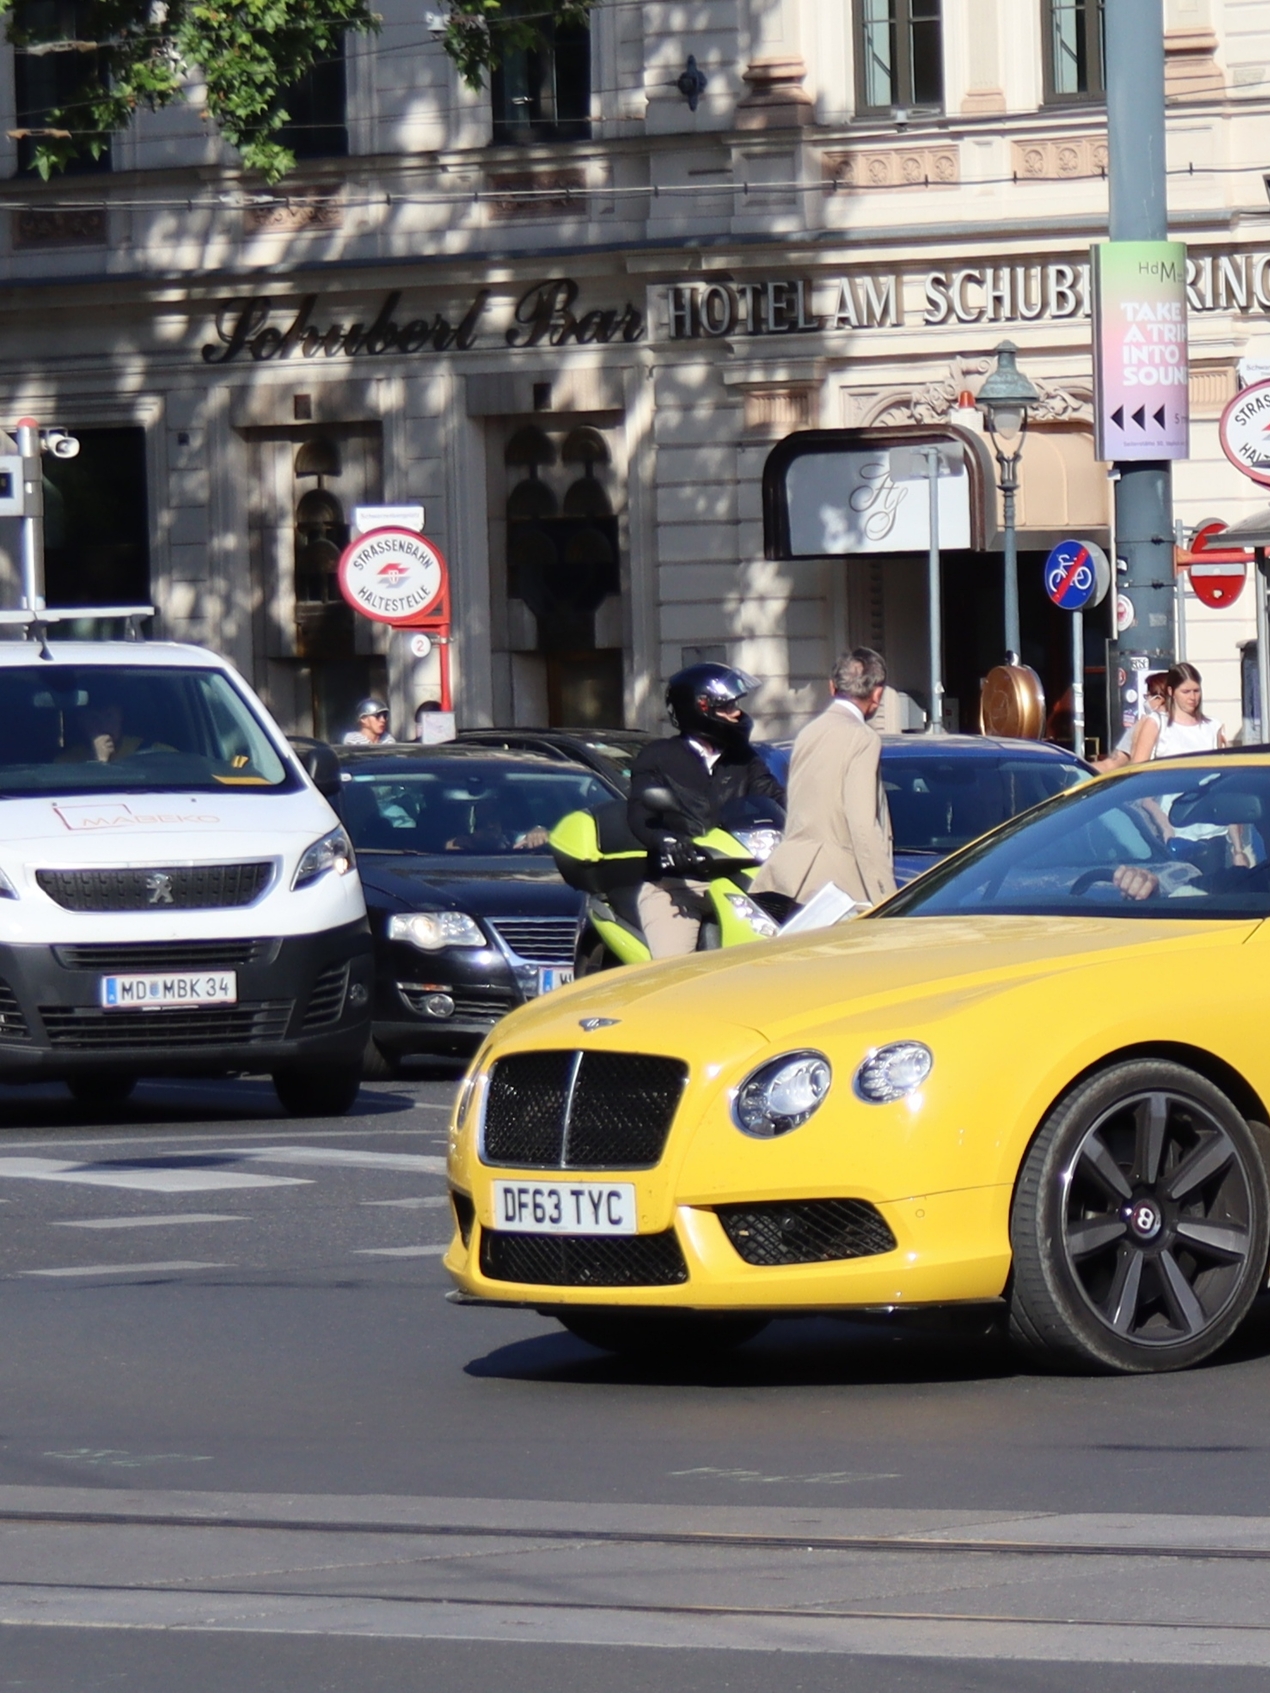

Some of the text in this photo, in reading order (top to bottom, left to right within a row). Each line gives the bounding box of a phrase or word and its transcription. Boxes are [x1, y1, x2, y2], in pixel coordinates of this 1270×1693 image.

[667, 279, 818, 338] HOTEL
[833, 272, 902, 328] AM
[1120, 301, 1182, 322] TAKE
[201, 277, 647, 365] Schubert Bar
[1123, 324, 1147, 344] A
[1122, 345, 1180, 365] INTO
[353, 538, 434, 571] STRASSENBAHN
[357, 584, 432, 612] HALTESTELLE
[416, 639, 425, 652] 2
[121, 980, 147, 1001] MD
[162, 977, 201, 999] MBK
[205, 976, 230, 997] 34
[502, 1187, 624, 1226] DF63 TYC
